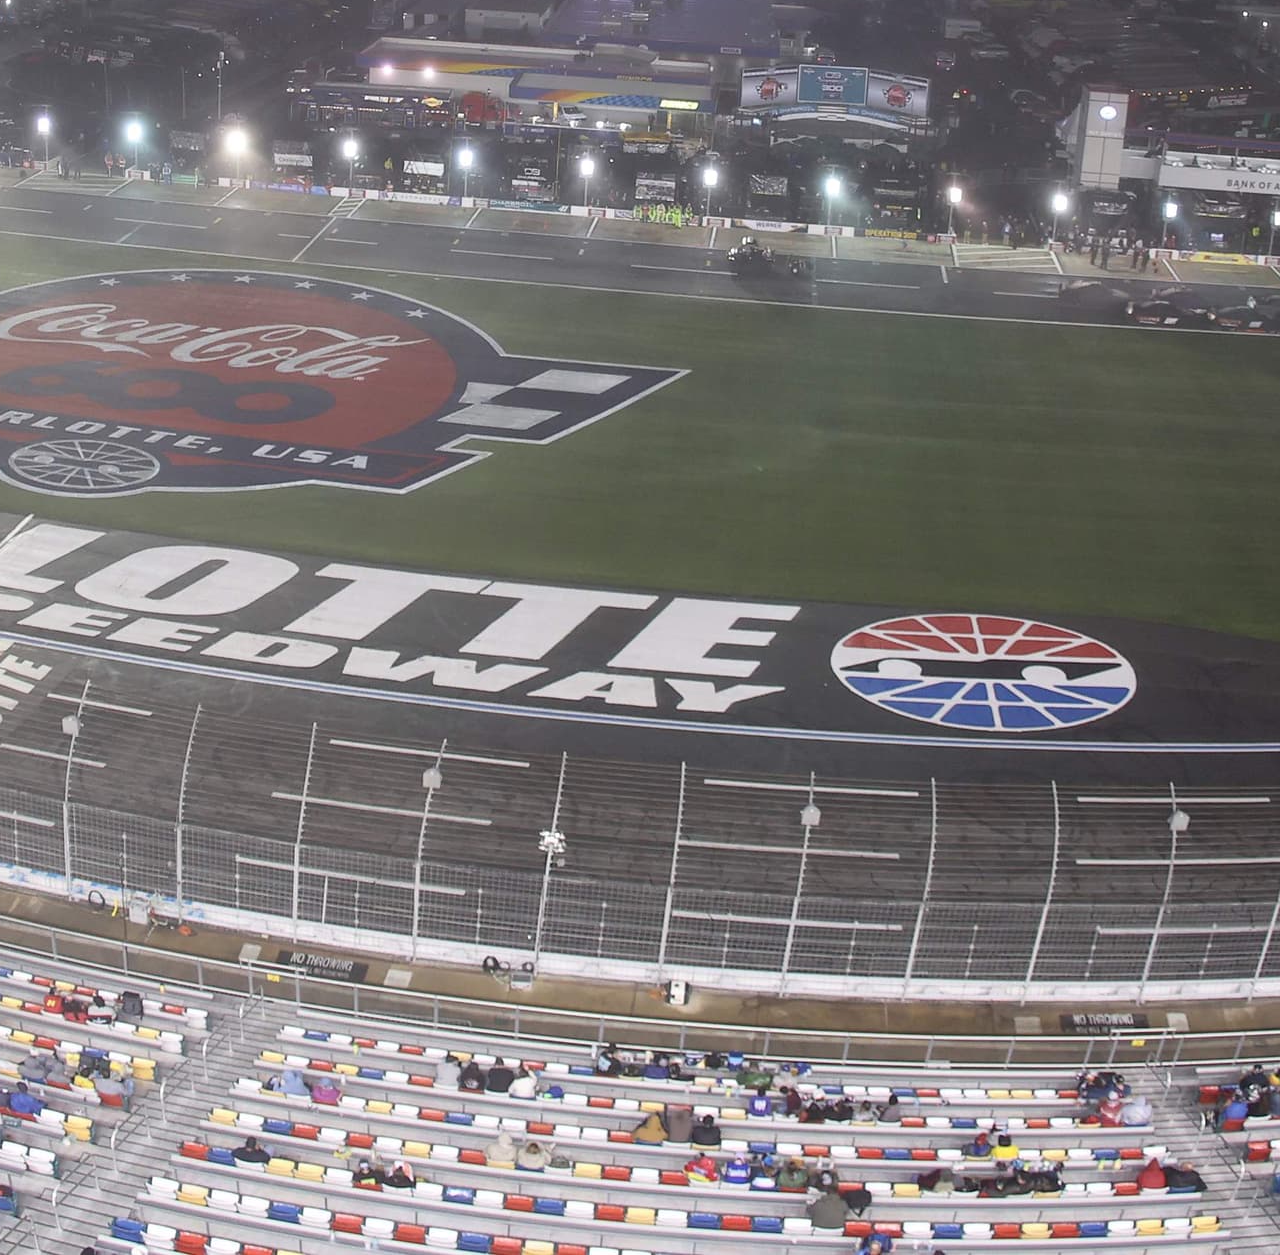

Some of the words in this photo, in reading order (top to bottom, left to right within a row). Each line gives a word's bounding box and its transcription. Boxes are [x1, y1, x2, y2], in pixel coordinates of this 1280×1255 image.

[1226, 178, 1255, 190] BANK
[1258, 181, 1272, 190] OF
[251, 443, 371, 471] USA
[290, 952, 305, 965] NO
[305, 955, 354, 971] THROWING
[1073, 1013, 1087, 1025] NO
[1087, 1013, 1135, 1026] THROWING
